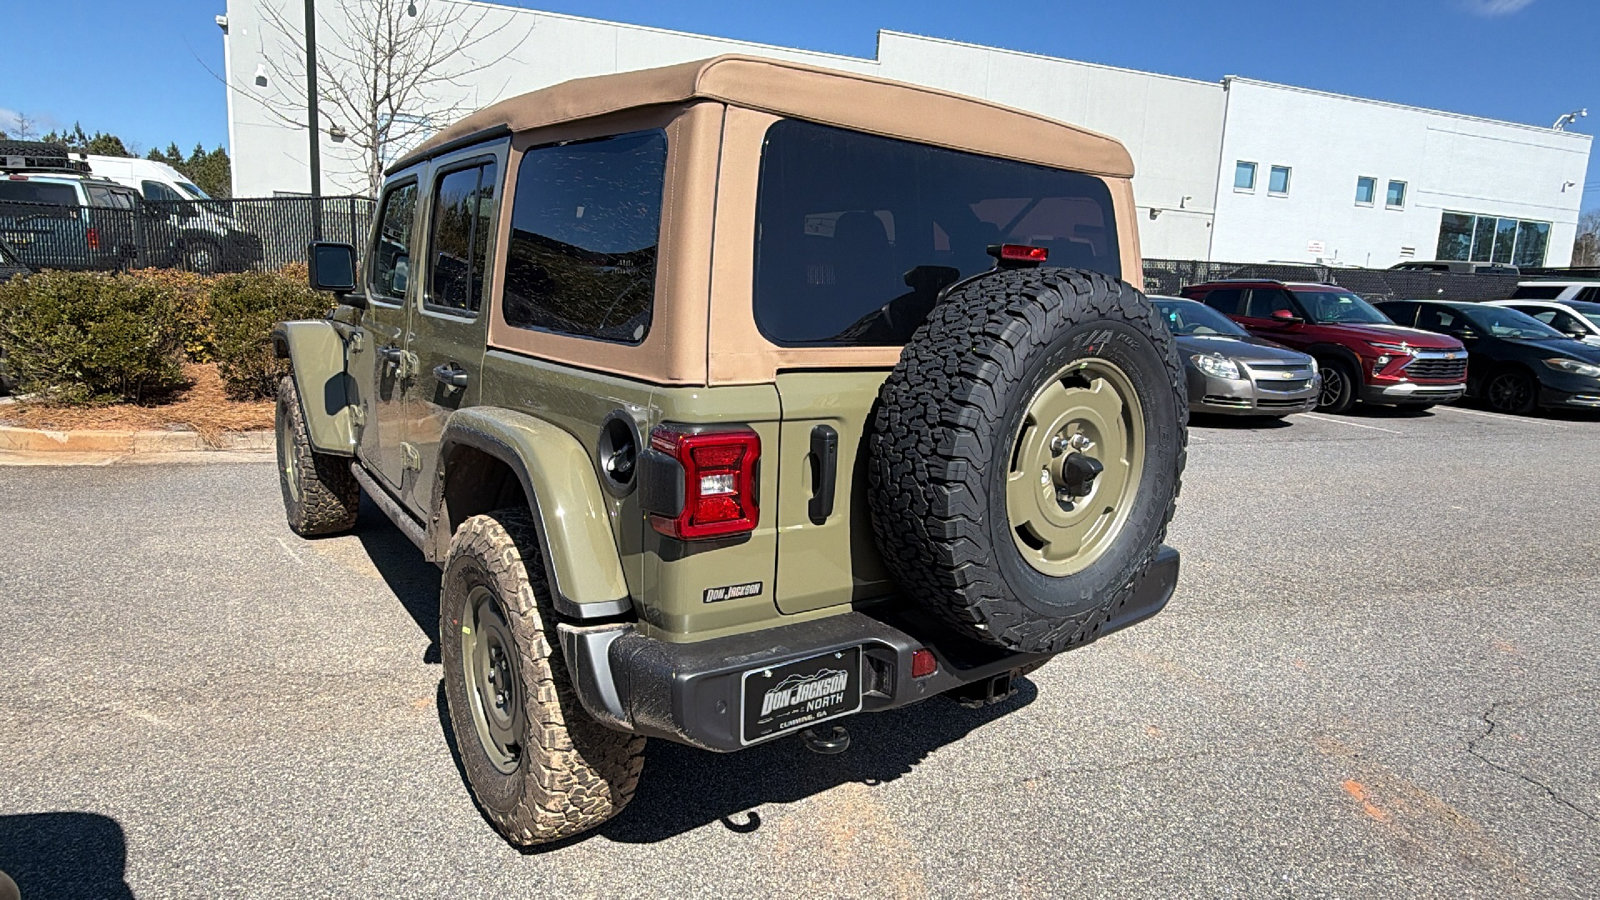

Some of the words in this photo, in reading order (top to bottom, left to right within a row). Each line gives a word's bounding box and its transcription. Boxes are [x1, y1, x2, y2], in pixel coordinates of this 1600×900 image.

[706, 589, 725, 602] DON
[725, 583, 760, 599] JACKSON
[761, 691, 791, 716] DON
[791, 674, 847, 704] JACKSON
[807, 693, 843, 712] NORTH
